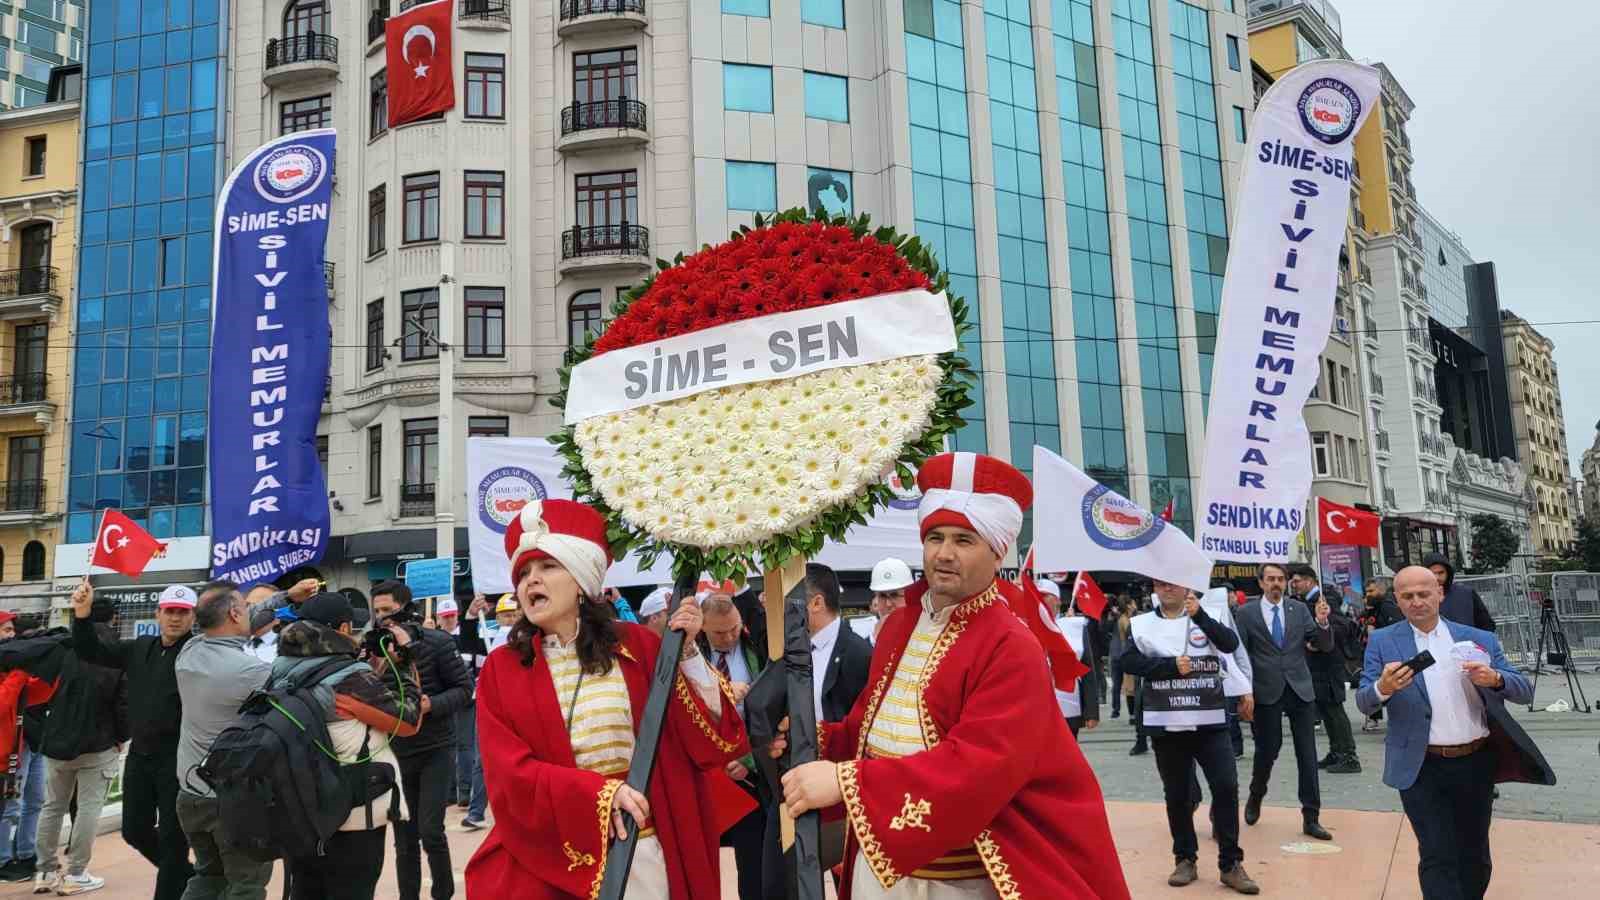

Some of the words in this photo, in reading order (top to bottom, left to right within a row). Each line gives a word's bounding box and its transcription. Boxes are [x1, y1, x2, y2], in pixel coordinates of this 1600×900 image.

[228, 203, 327, 233] SİME-SEN
[1274, 179, 1320, 293] SİVİL
[254, 235, 288, 331] SİVİL
[624, 346, 728, 400] SİME
[768, 316, 859, 373] SEN
[1239, 306, 1300, 489] MEMURLAR
[248, 343, 289, 516] MEMURLAR
[1202, 532, 1260, 555] İSTANBUL
[1264, 541, 1288, 559] ŞUB
[1207, 502, 1301, 532] SENDİKASI
[216, 559, 278, 584] TANBUL
[1168, 695, 1201, 707] YATAMAZ
